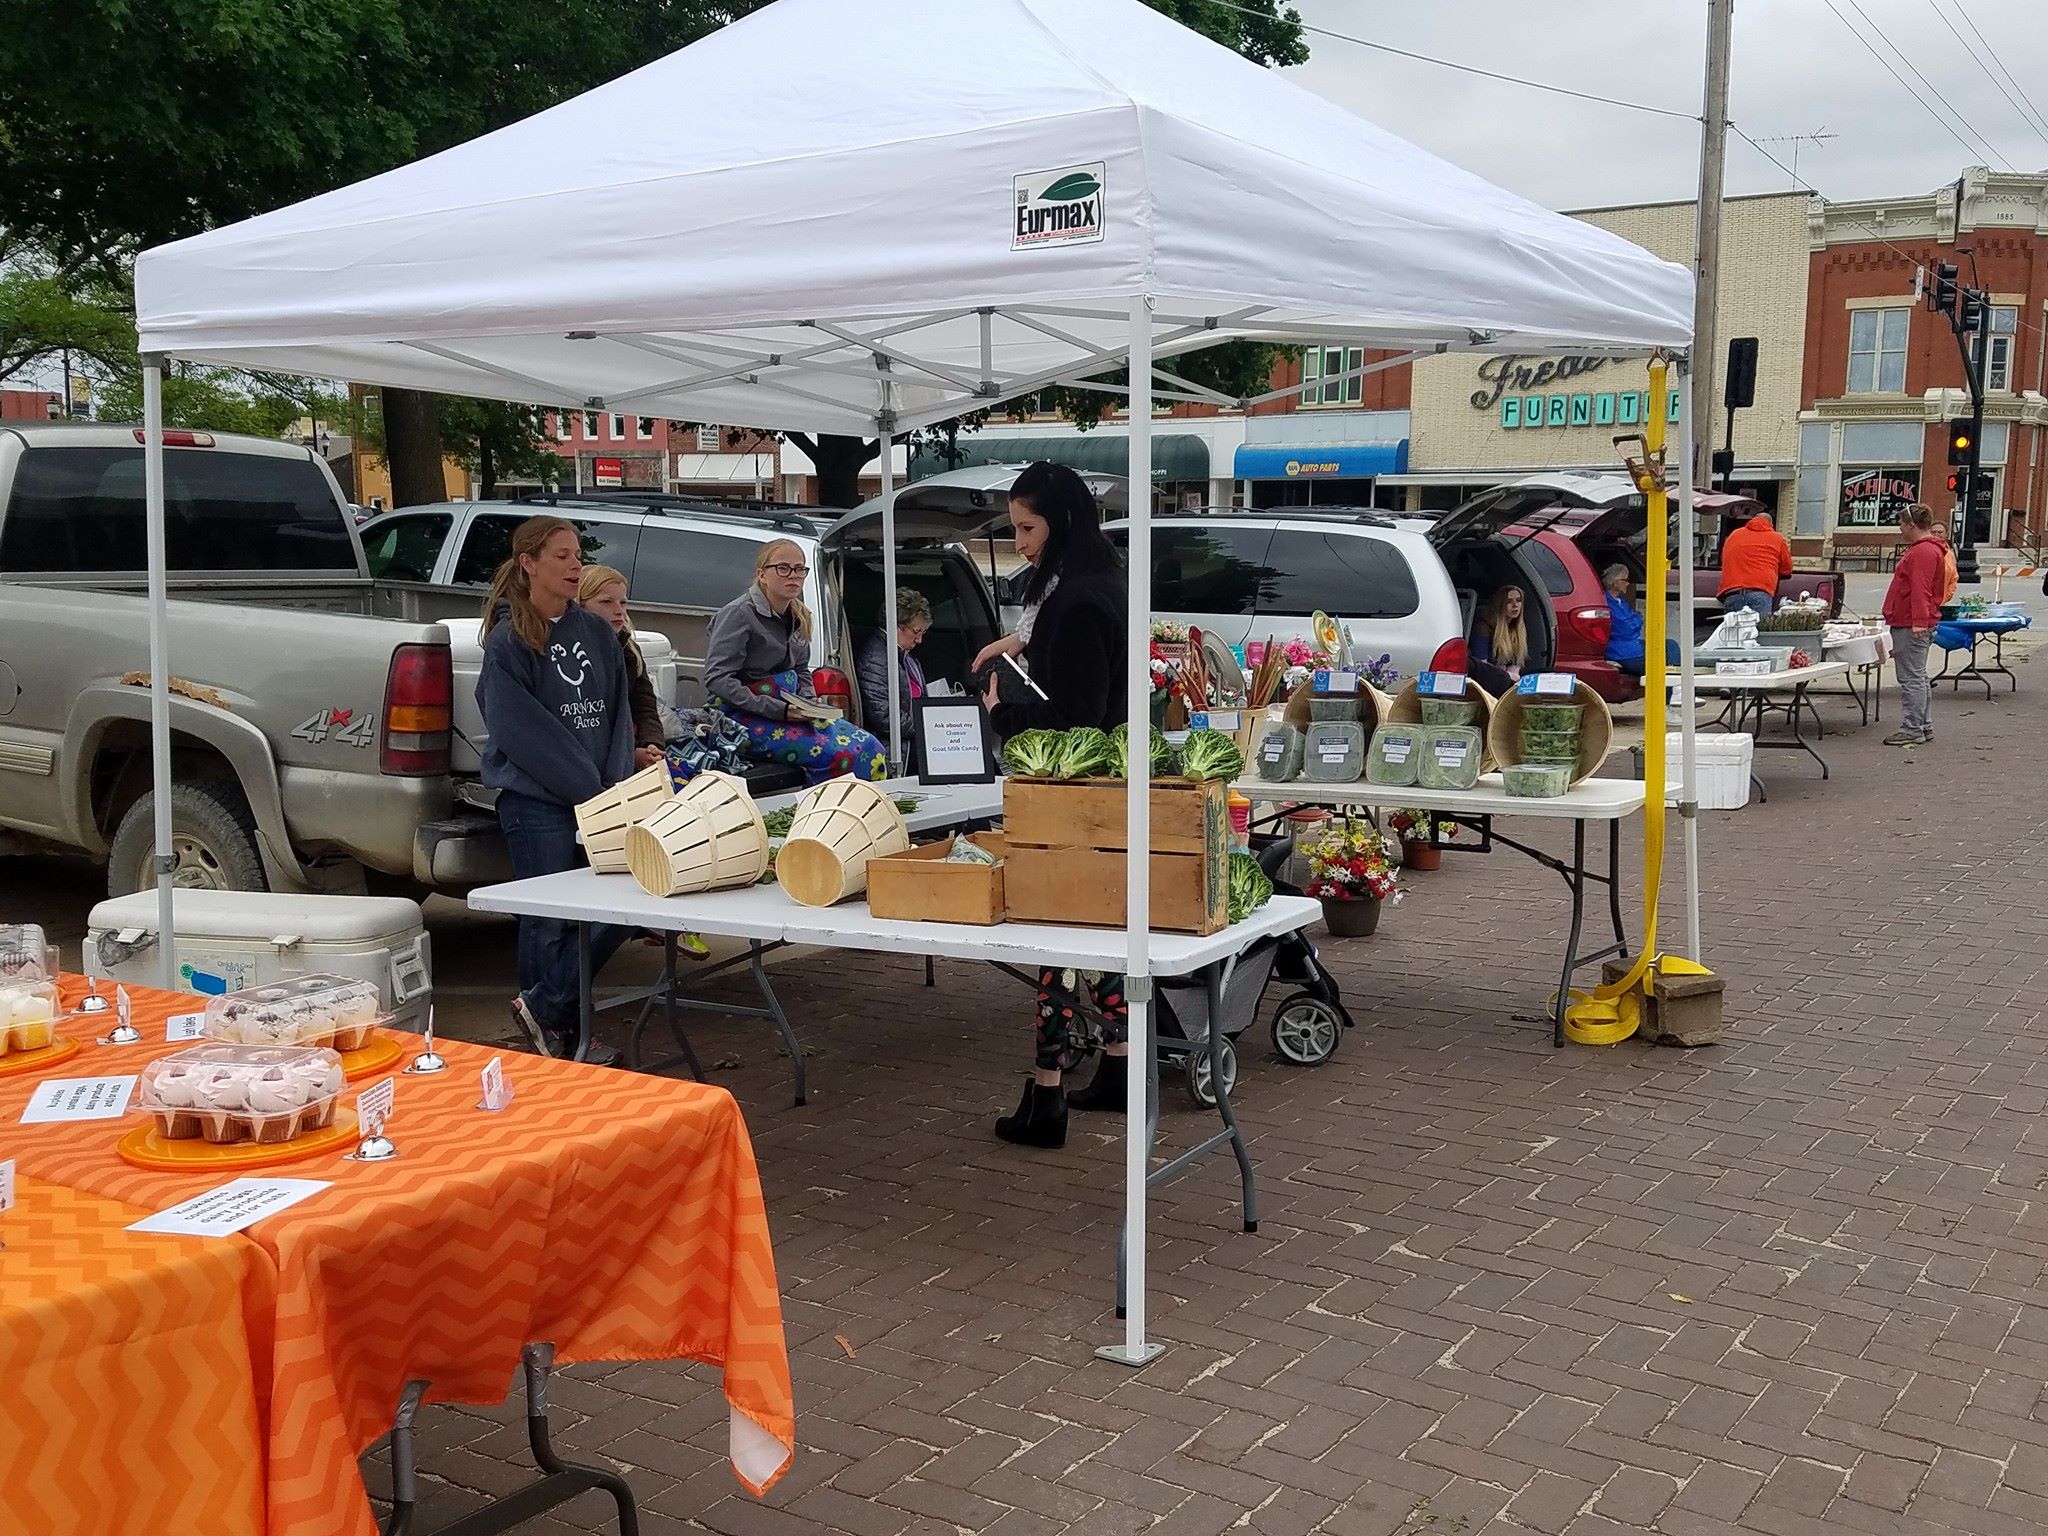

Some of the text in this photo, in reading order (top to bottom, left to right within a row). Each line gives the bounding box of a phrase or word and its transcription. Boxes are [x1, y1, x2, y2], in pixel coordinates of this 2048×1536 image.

[1017, 200, 1095, 236] Eurmax
[1504, 394, 1680, 423] FURNITR
[1874, 407, 1920, 415] BUILDING
[1963, 408, 2018, 416] MECANTILE
[1301, 463, 1319, 472] AUTO
[1319, 463, 1340, 472] PARTS
[1845, 478, 1916, 502] SCHUCK
[560, 698, 606, 717] ARNKA
[573, 715, 601, 729] Acres
[184, 1201, 227, 1221] contain
[200, 1187, 278, 1224] dairy products
[222, 1191, 291, 1224] and/or nuts.
